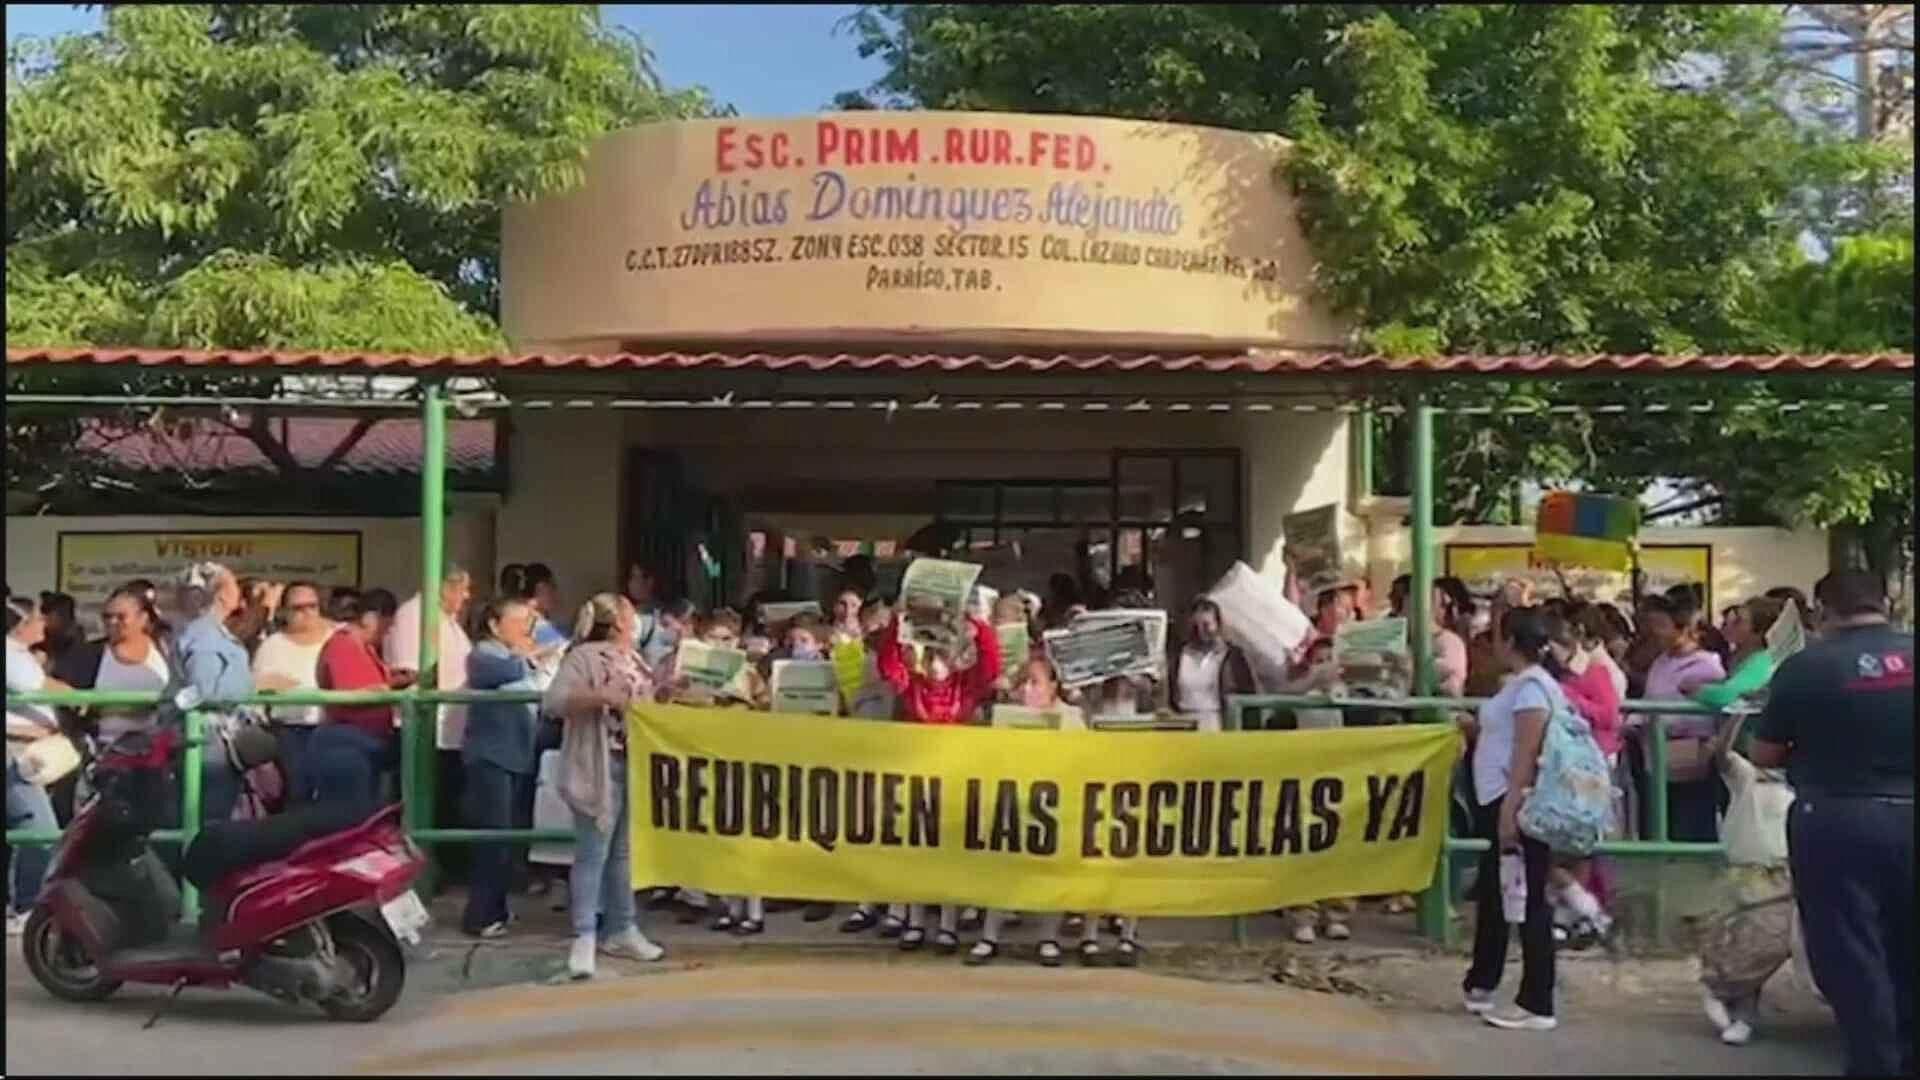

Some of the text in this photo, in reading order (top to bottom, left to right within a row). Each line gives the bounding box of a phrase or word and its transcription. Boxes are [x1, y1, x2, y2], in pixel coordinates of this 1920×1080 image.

[1038, 180, 1184, 237] Alejandro
[649, 751, 1425, 859] REUBIQUEN LAS ESCUELAS YA
